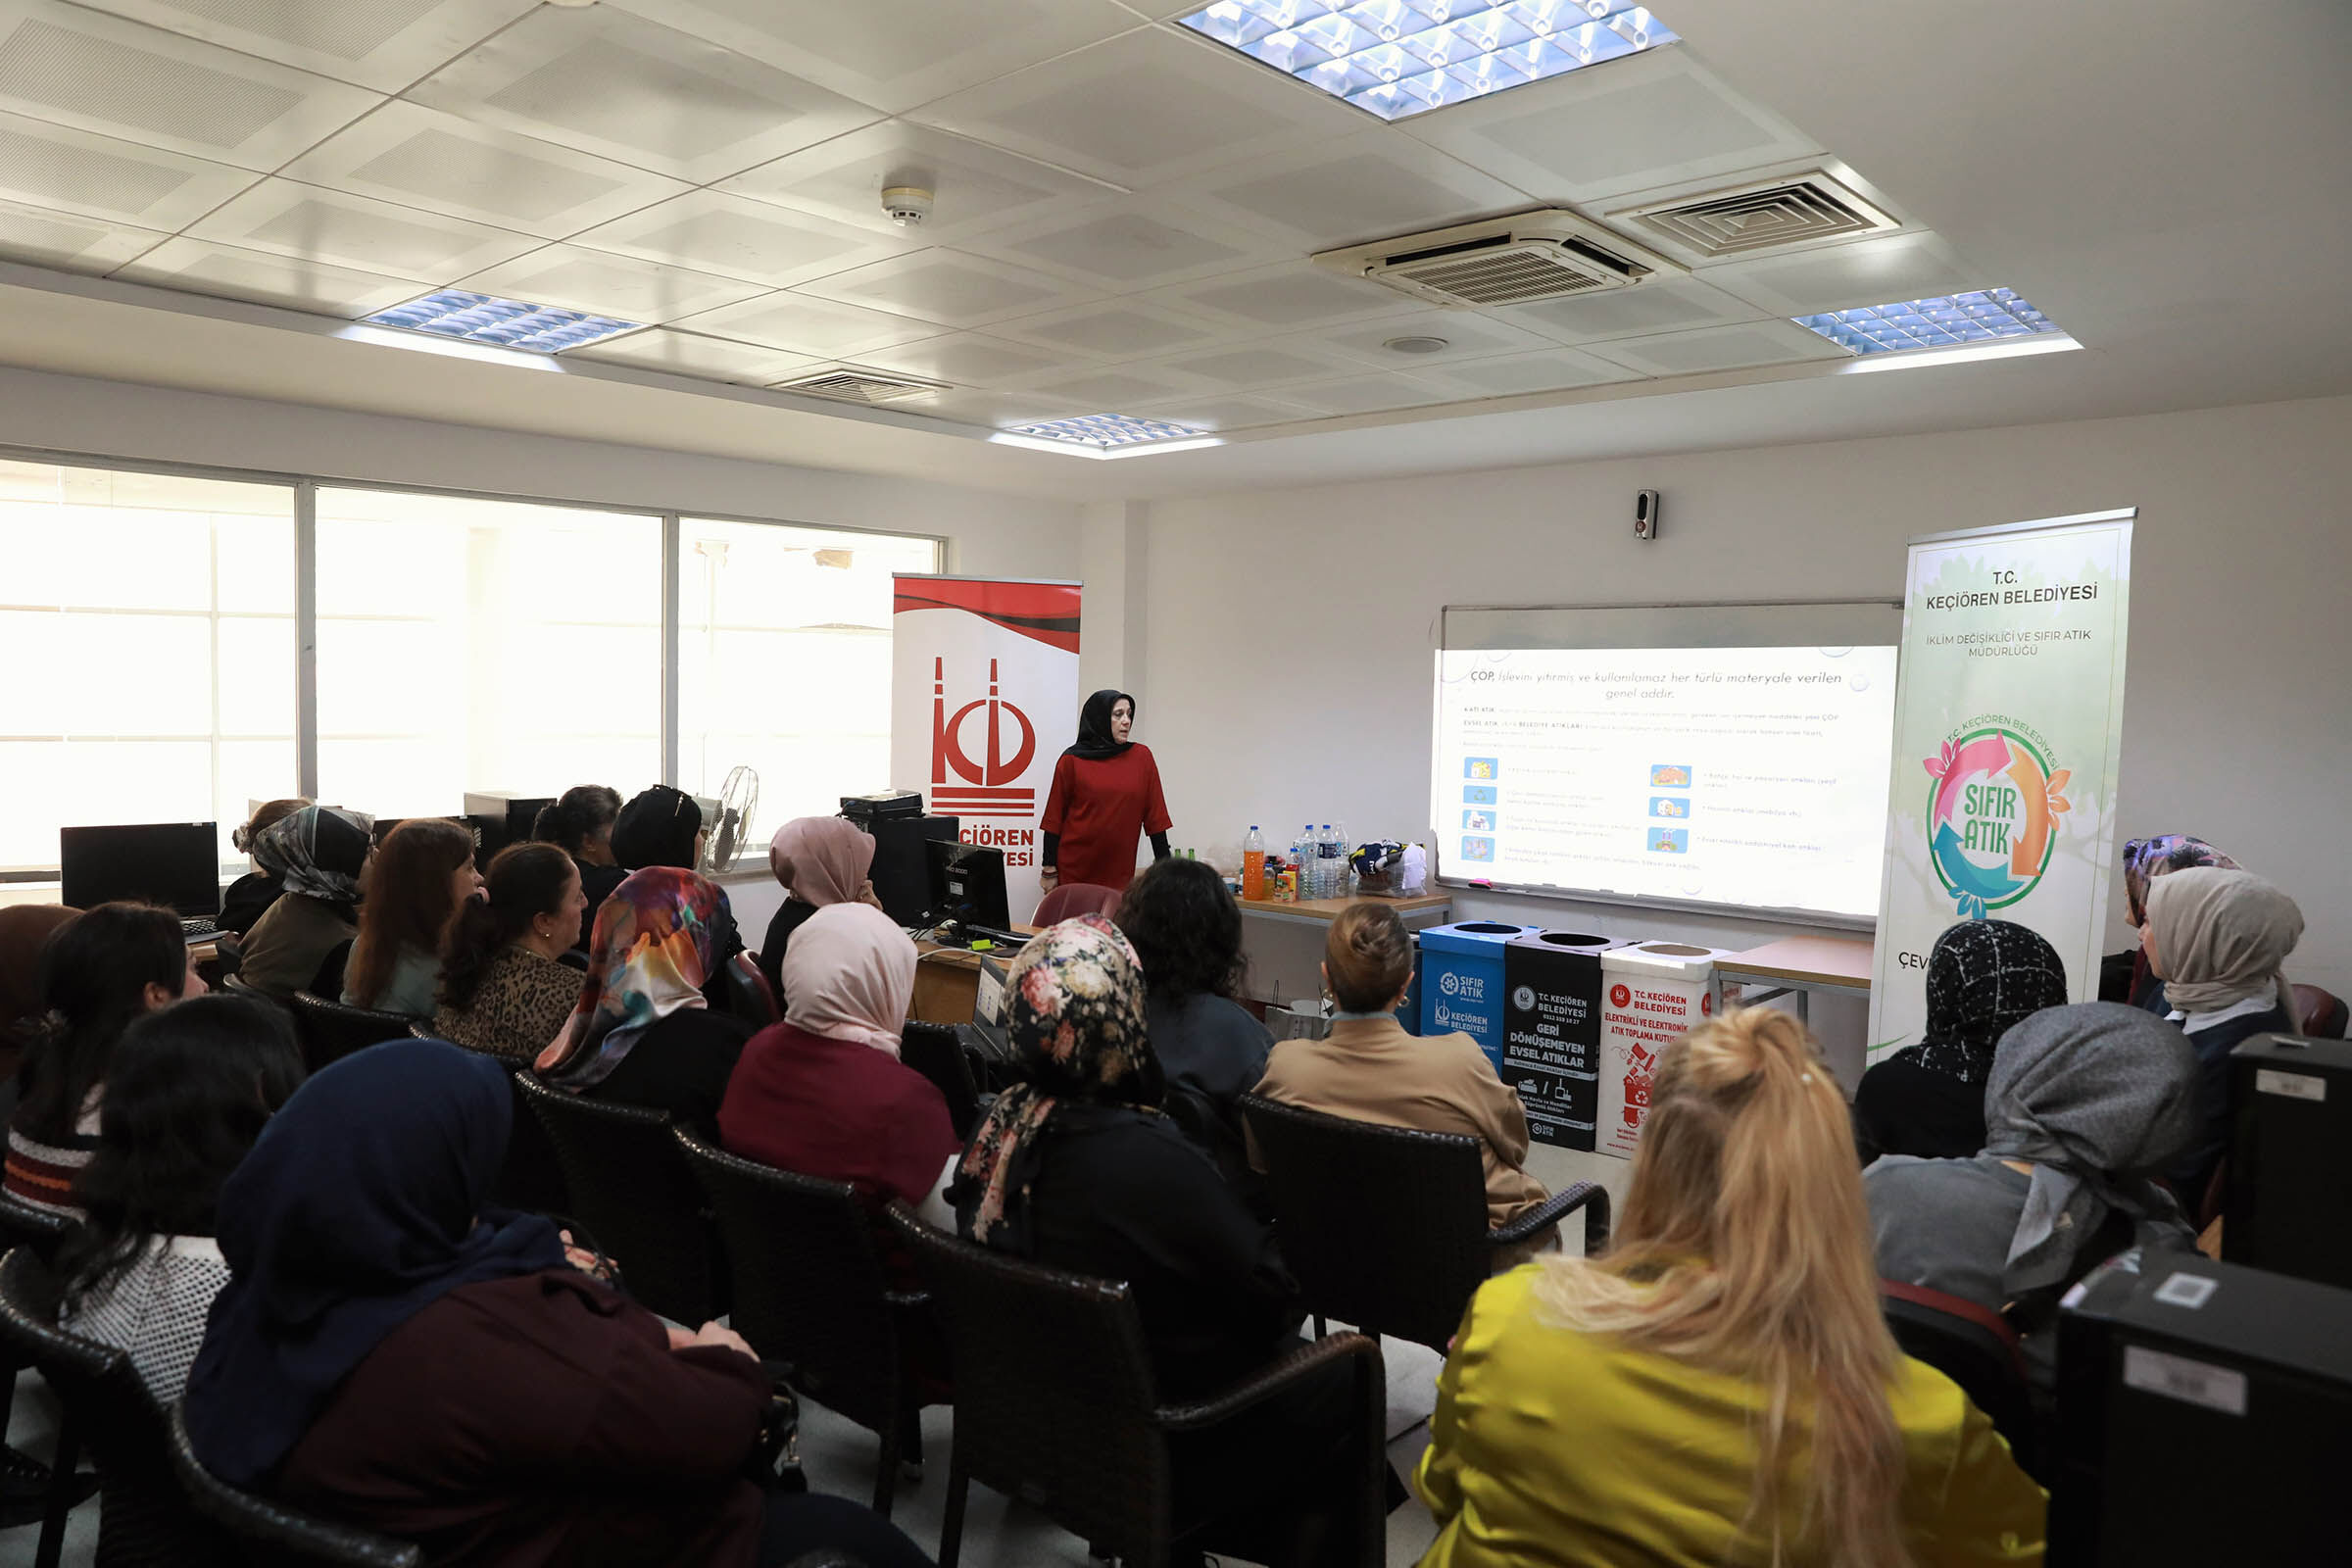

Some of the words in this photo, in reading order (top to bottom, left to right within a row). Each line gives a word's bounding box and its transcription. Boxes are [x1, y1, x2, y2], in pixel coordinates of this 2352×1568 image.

[1992, 570, 2018, 585] T.C.
[1927, 591, 1999, 612] KEÇİÖREN
[2003, 581, 2098, 605] BELEDİYESİ
[1926, 633, 1954, 646] İKLİM
[1957, 629, 2015, 646] DEĞİŞİKLİĞİ
[2017, 631, 2032, 642] VE
[2034, 630, 2061, 642] SIFIR
[2064, 629, 2092, 641] ATIK
[1969, 644, 2038, 658] MÜDÜRLÜĞÜ
[1578, 673, 1592, 683] ve
[1670, 671, 1690, 683] her
[1694, 671, 1723, 683] türlü
[1727, 671, 1792, 685] materyale
[1797, 671, 1841, 684] verilen
[1605, 687, 1638, 701] genel
[1947, 729, 1962, 743] T.C.
[1962, 713, 2012, 730] KEÇİÖREN
[2013, 719, 2061, 770] BELEDİYESİ
[1964, 784, 2017, 819] SIFIR
[1965, 819, 2011, 855] ATIK
[1898, 952, 1929, 969] ÇEV
[1459, 975, 1484, 989] SIFIR
[1459, 986, 1483, 998] ATIK
[1647, 992, 1687, 1005] KEÇİÖREN
[1550, 994, 1587, 1007] KEÇİÖREN
[1538, 1003, 1587, 1019] BELEDİYESİ
[1634, 1001, 1687, 1016] BELEDİYESİ
[1450, 1011, 1488, 1025] KEÇİÖREN
[1604, 1012, 1640, 1026] ELEKTRİKLİ
[1640, 1018, 1647, 1027] VE
[1648, 1019, 1689, 1034] ELEKTRONİK
[1450, 1021, 1488, 1034] BELEDİYESİ
[1536, 1022, 1560, 1037] GERİ
[1610, 1026, 1624, 1036] ATIK
[1625, 1028, 1654, 1041] TOPLAMA
[1654, 1032, 1679, 1044] KUTUS
[1509, 1031, 1586, 1055] DÖNÜŞEMEYEN
[1509, 1045, 1541, 1060] EVSEL
[1542, 1052, 1585, 1068] ATIKLAR
